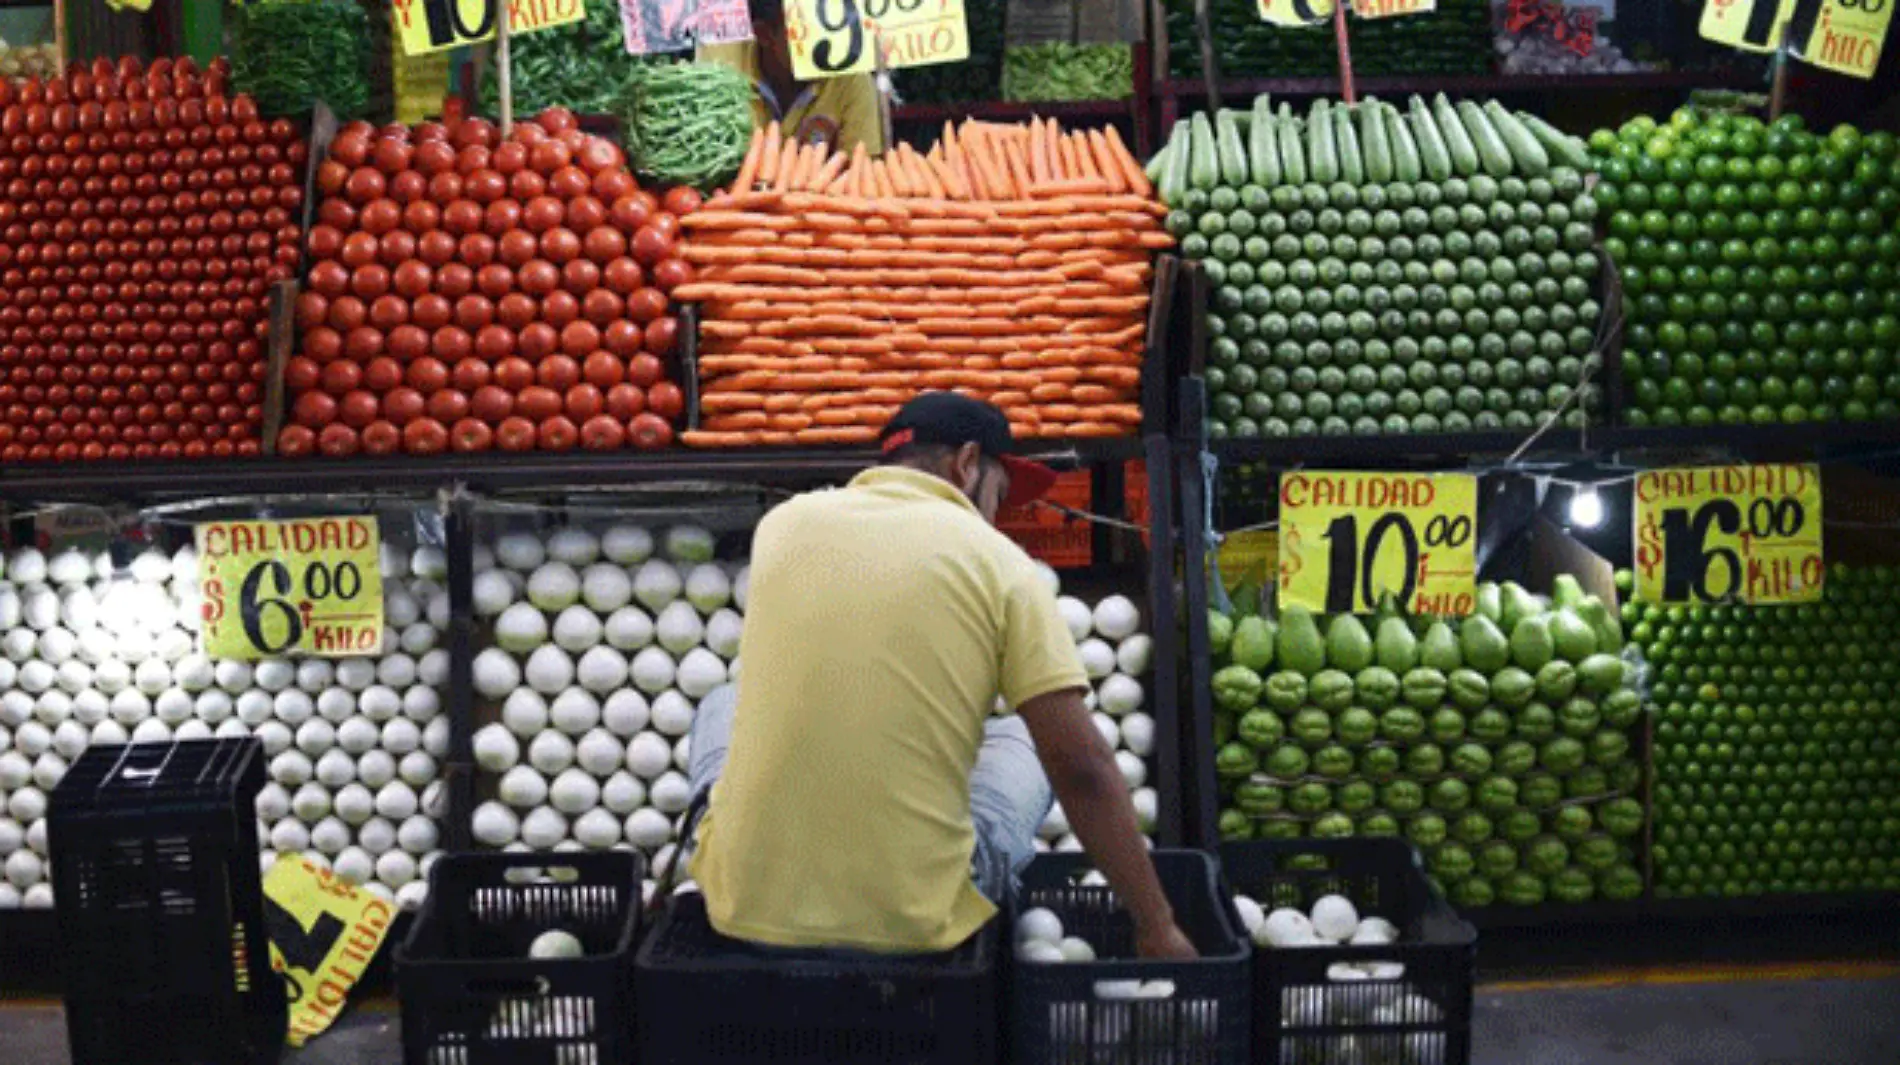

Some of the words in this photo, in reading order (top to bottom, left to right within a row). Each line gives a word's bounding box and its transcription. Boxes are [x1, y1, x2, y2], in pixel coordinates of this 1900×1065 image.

[1280, 475, 1435, 508] CALIDAD
[1637, 463, 1805, 503] CALIDAD
[206, 518, 369, 556] CALIDAD
